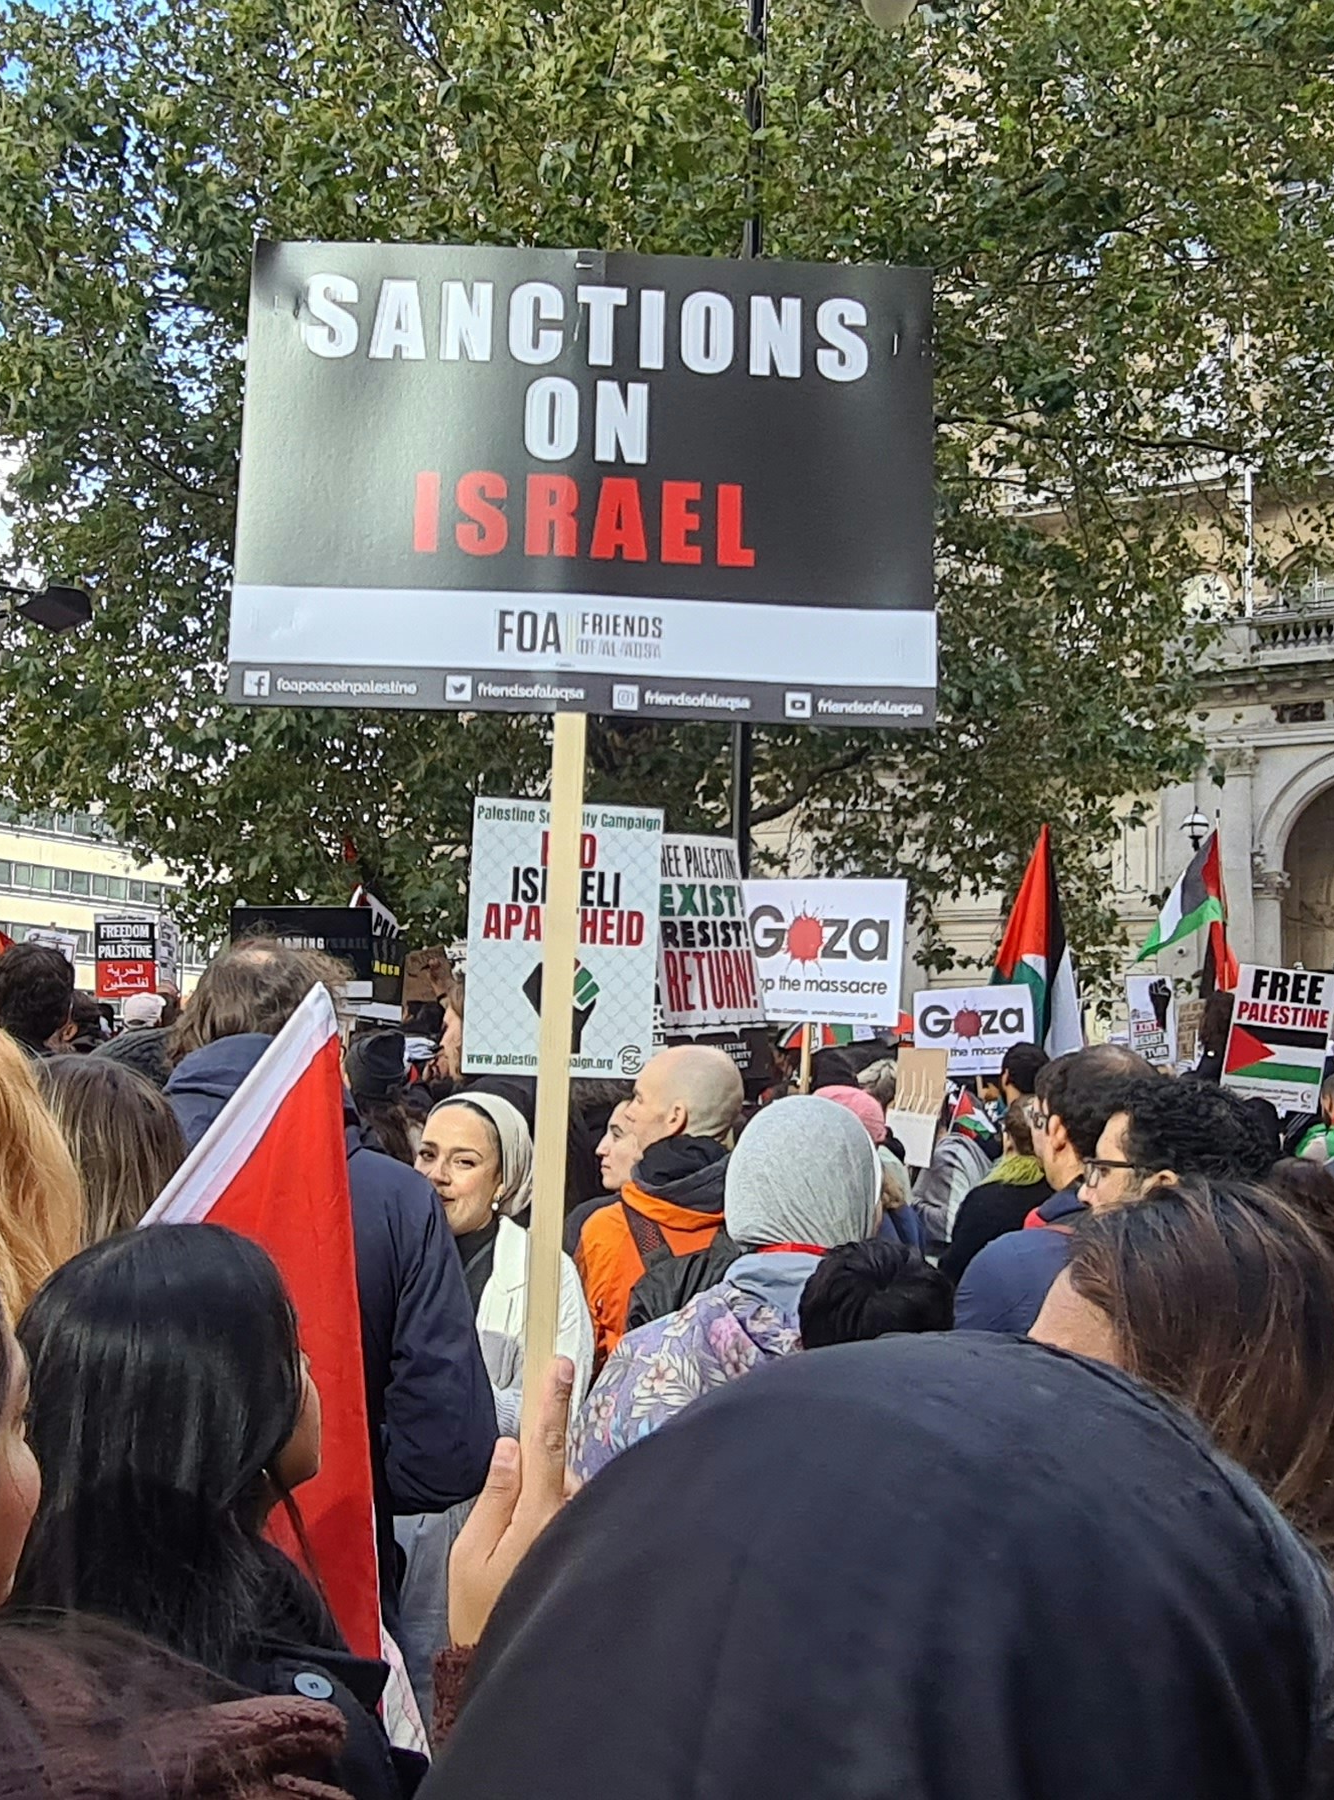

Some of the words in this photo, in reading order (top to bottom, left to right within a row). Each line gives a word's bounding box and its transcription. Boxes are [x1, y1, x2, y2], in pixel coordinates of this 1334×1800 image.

[304, 271, 869, 384] SANCTIONS
[524, 375, 650, 466] ON
[412, 470, 756, 569] ISRAEL
[496, 609, 563, 655] FOA
[580, 611, 664, 639] FRIENDS
[275, 676, 419, 697] foapeaceinpalestine
[477, 681, 586, 703] friendsofalaqsa
[643, 689, 752, 713] friendsofalaqsa
[816, 697, 924, 721] friendsofalaqsa
[1271, 700, 1325, 724] THE
[477, 804, 535, 823] Palestine
[601, 813, 662, 832] Campaign
[660, 844, 681, 878] REE
[511, 866, 622, 909] ISELI
[659, 883, 746, 918] EXIST!
[100, 924, 149, 939] FREEDOM
[482, 902, 644, 947] APAHEID
[660, 920, 751, 949] RESIST!
[748, 904, 890, 962] Gza
[97, 944, 153, 959] PALESTINE
[664, 949, 758, 1013] RETURN!
[779, 975, 801, 992] the
[803, 978, 888, 996] massacre
[1251, 968, 1325, 1006] FREE
[918, 1004, 1025, 1039] Gza
[1236, 1000, 1330, 1029] PALESTINE
[950, 1046, 969, 1057] the
